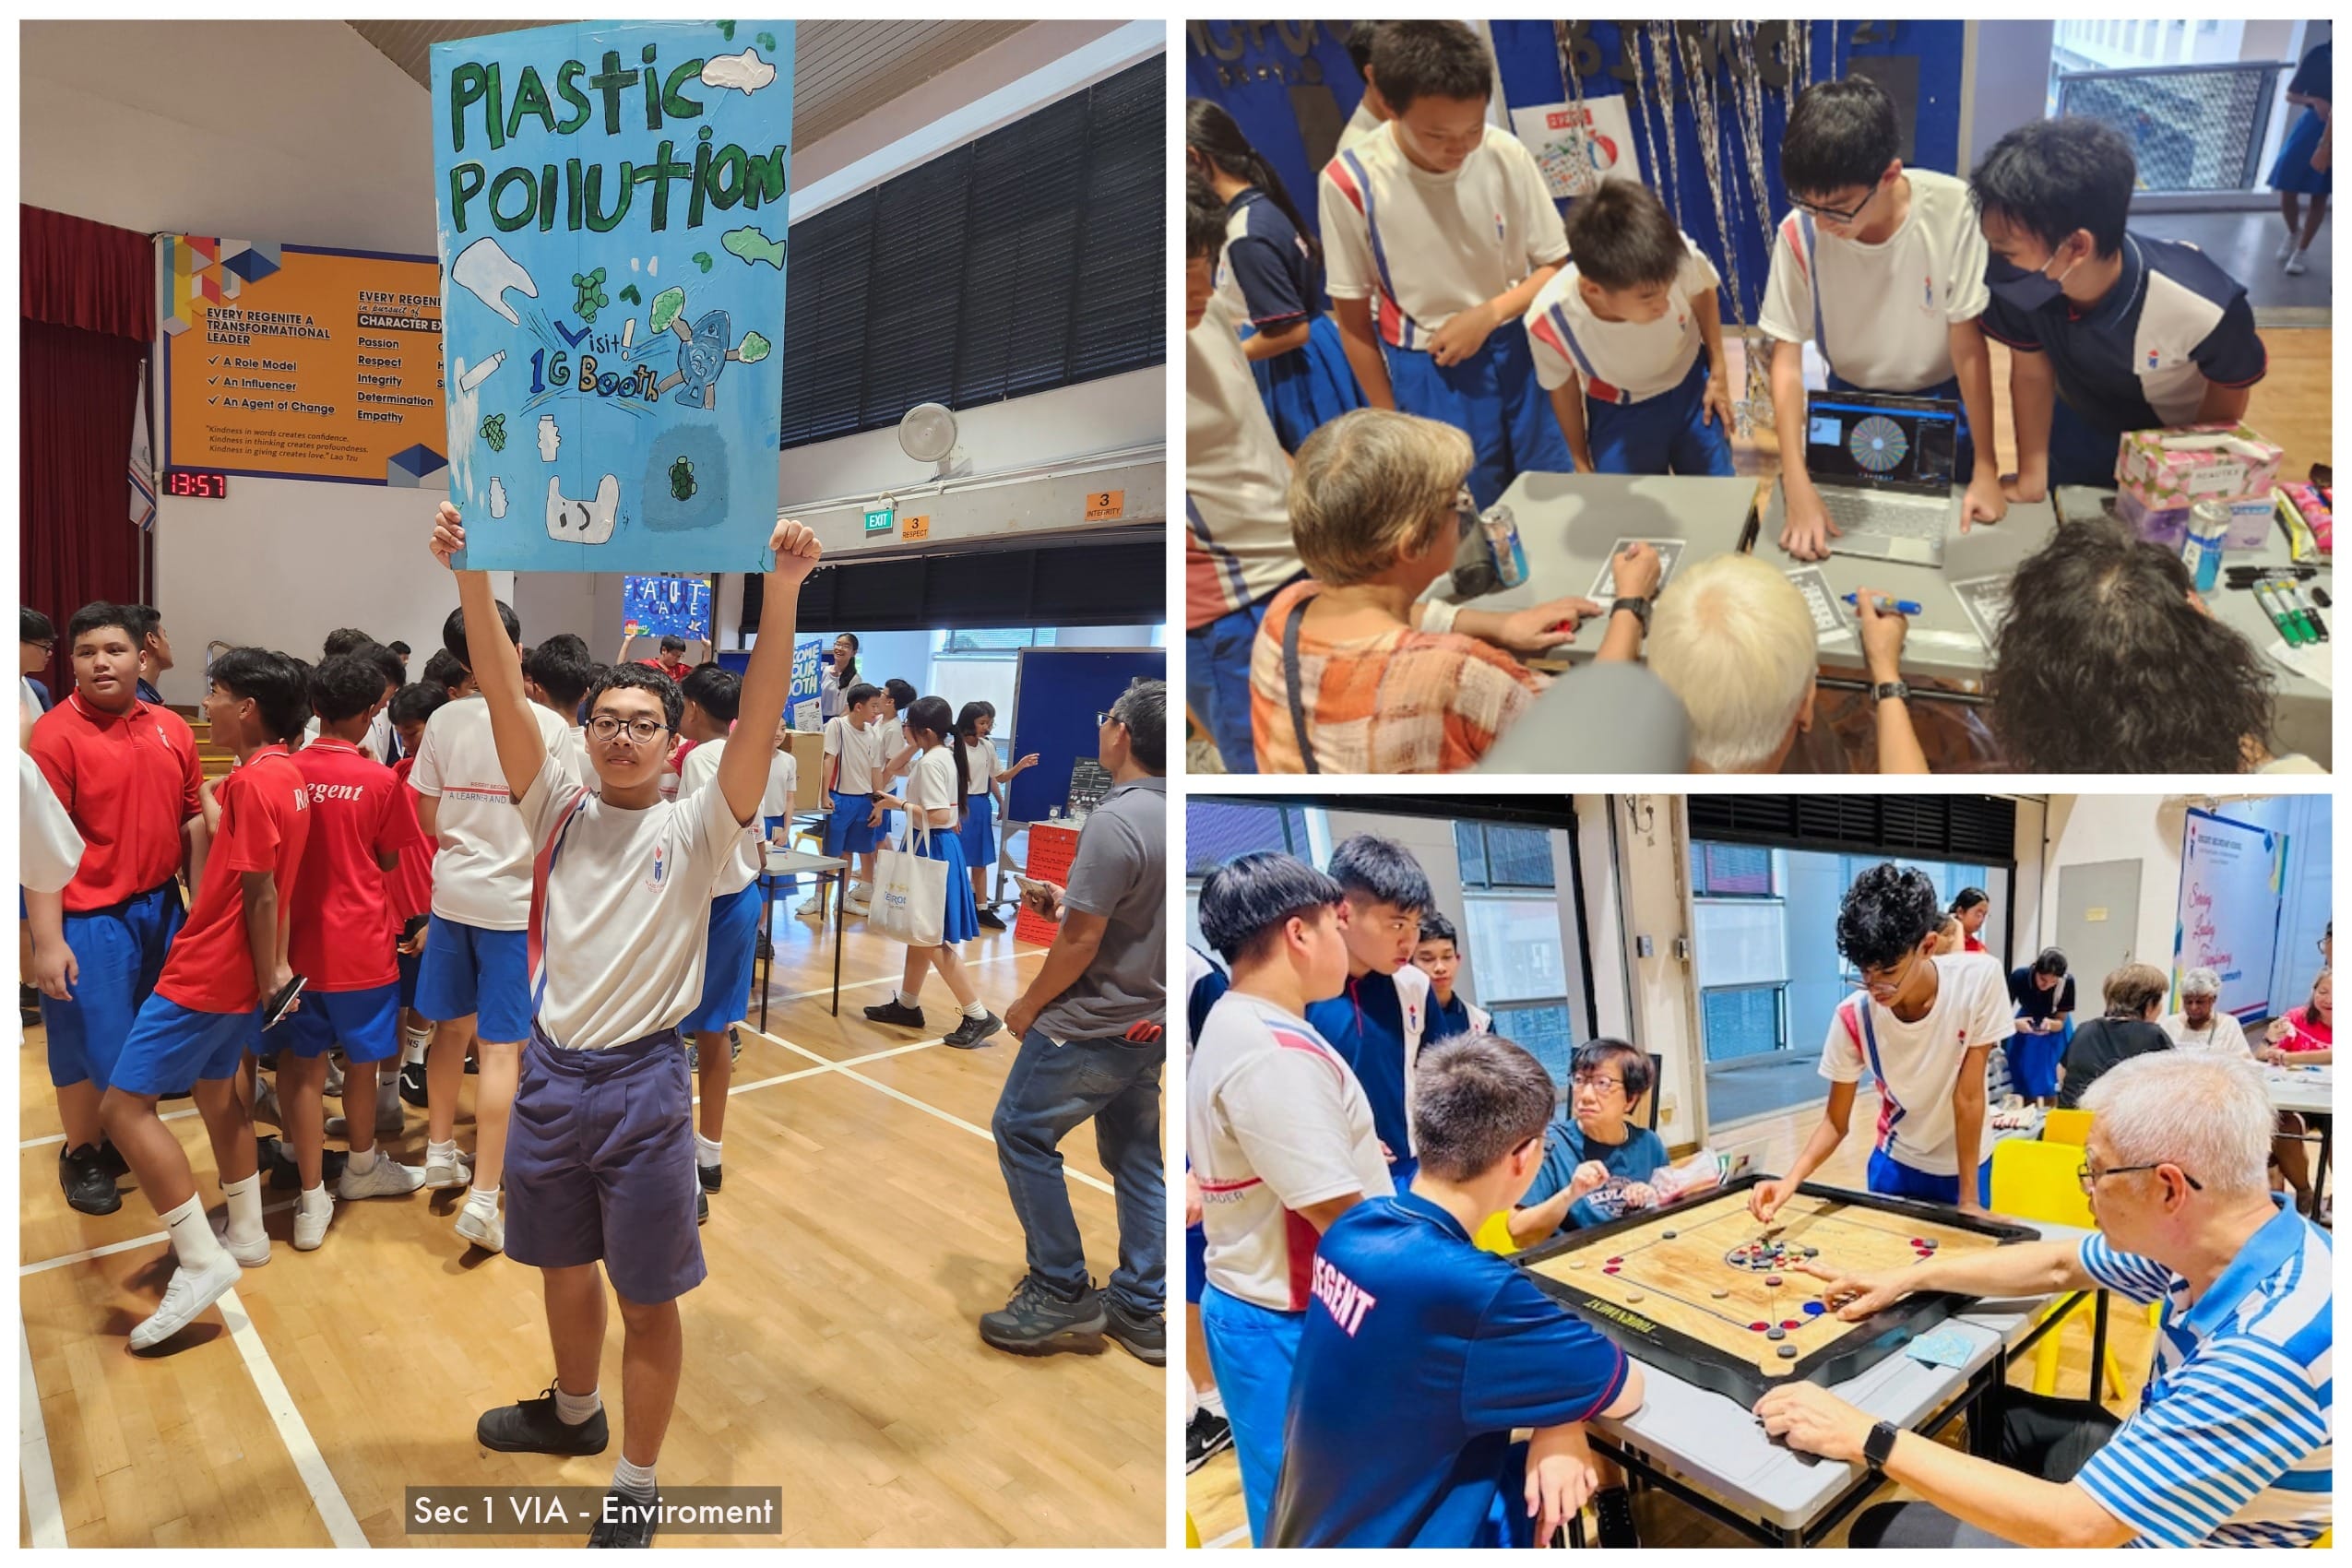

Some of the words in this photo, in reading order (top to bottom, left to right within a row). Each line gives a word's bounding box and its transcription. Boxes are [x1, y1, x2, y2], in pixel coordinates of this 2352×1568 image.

[359, 291, 395, 303] EVERY
[207, 307, 244, 320] EVERY
[247, 311, 302, 325] REGENITE
[305, 315, 315, 326] A
[372, 305, 406, 315] pursuit
[410, 306, 421, 317] of
[207, 320, 331, 339] TRANSFORMATIONAL
[360, 315, 428, 330] CHARACTER
[207, 332, 251, 345] LEADER
[358, 337, 399, 349] Passion
[223, 357, 232, 366] A
[235, 358, 259, 368] Role
[262, 360, 297, 371] Model
[358, 355, 402, 368] Respect
[358, 374, 402, 387] Integrity
[529, 348, 571, 394] 1G
[578, 354, 660, 403] Booth
[223, 377, 239, 386] An
[242, 378, 297, 391] Influencer
[357, 391, 434, 407] Determination
[223, 397, 239, 407] An
[242, 398, 275, 410] Agent
[277, 402, 289, 410] of
[291, 401, 336, 416] Change
[357, 410, 404, 424] Empathy
[254, 429, 277, 437] words
[278, 431, 306, 439] creates
[307, 433, 349, 443] confidence.
[209, 435, 243, 444] Kindness
[254, 438, 286, 449] thinking
[287, 441, 315, 449] creates
[315, 442, 369, 454] profoundness.
[209, 445, 243, 454] Kindness
[254, 448, 278, 457] giving
[279, 450, 306, 458] creates
[330, 453, 344, 461] Lao
[346, 454, 359, 462] Tzu
[171, 473, 224, 496] 13:57
[1099, 493, 1110, 506] 3
[1087, 507, 1121, 517] INTEGRITY
[869, 514, 888, 528] EXIT
[911, 517, 920, 529] 3
[902, 529, 929, 539] RESPECT
[489, 795, 507, 804] AND
